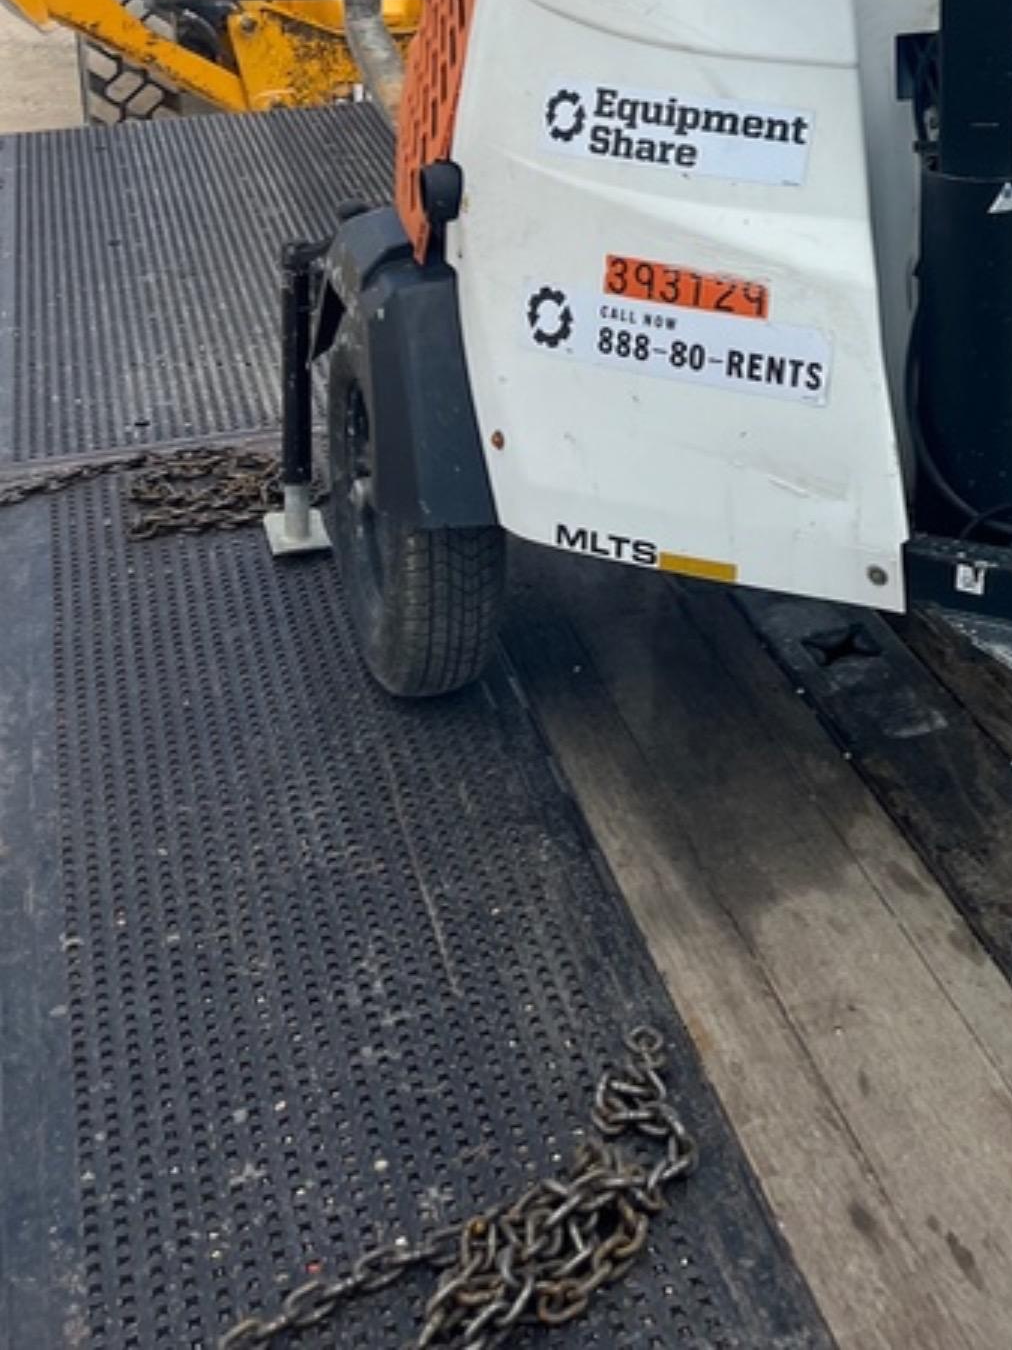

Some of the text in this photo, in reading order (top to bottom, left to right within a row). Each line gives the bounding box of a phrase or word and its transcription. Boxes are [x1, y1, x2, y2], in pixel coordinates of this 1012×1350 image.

[593, 87, 808, 144] Equipment
[589, 125, 697, 167] Share
[600, 305, 677, 330] CALL NOW
[597, 327, 823, 391] 888-80-RENTS
[556, 523, 657, 565] MLTS
